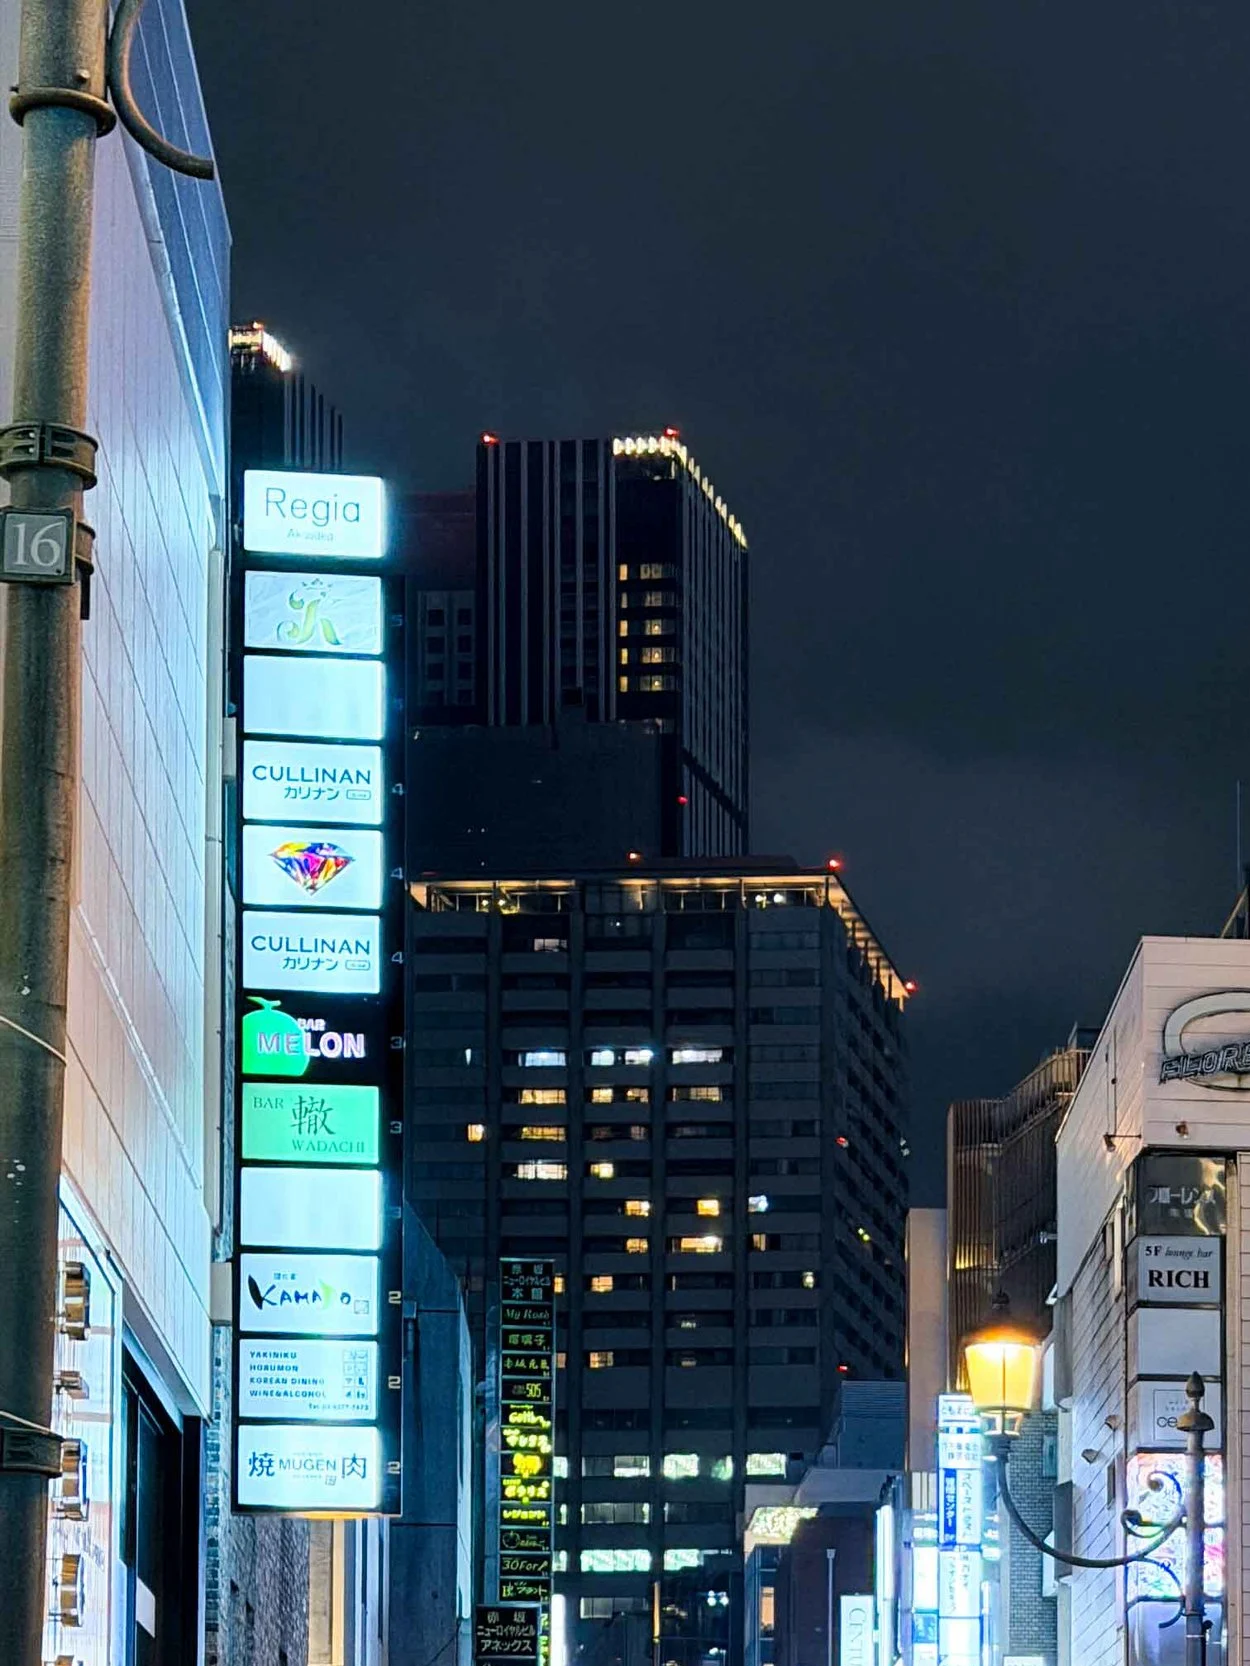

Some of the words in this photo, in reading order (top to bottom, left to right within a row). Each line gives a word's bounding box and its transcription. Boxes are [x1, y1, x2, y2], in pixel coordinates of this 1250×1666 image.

[265, 487, 360, 526] Regia
[14, 521, 64, 568] 16
[252, 765, 371, 785] CULLINAN
[284, 786, 339, 800] カリナン
[251, 935, 370, 955] CULLINAN
[282, 957, 338, 970] カリナン
[297, 1018, 326, 1031] BAR
[258, 1032, 366, 1058] MELON
[253, 1096, 284, 1110] BAR
[292, 1139, 365, 1153] WADACHI
[1145, 1245, 1162, 1256] 5F
[1148, 1269, 1210, 1288] RICH
[250, 1351, 297, 1360] YAKINIKU
[250, 1364, 299, 1372] HORUMON
[250, 1377, 288, 1385] KOREAN
[249, 1452, 276, 1478] 焼
[279, 1458, 337, 1472] MUGEN
[341, 1453, 367, 1479] 肉
[477, 1625, 536, 1636] ニューロイヤルビル
[481, 1639, 533, 1652] アネックス
